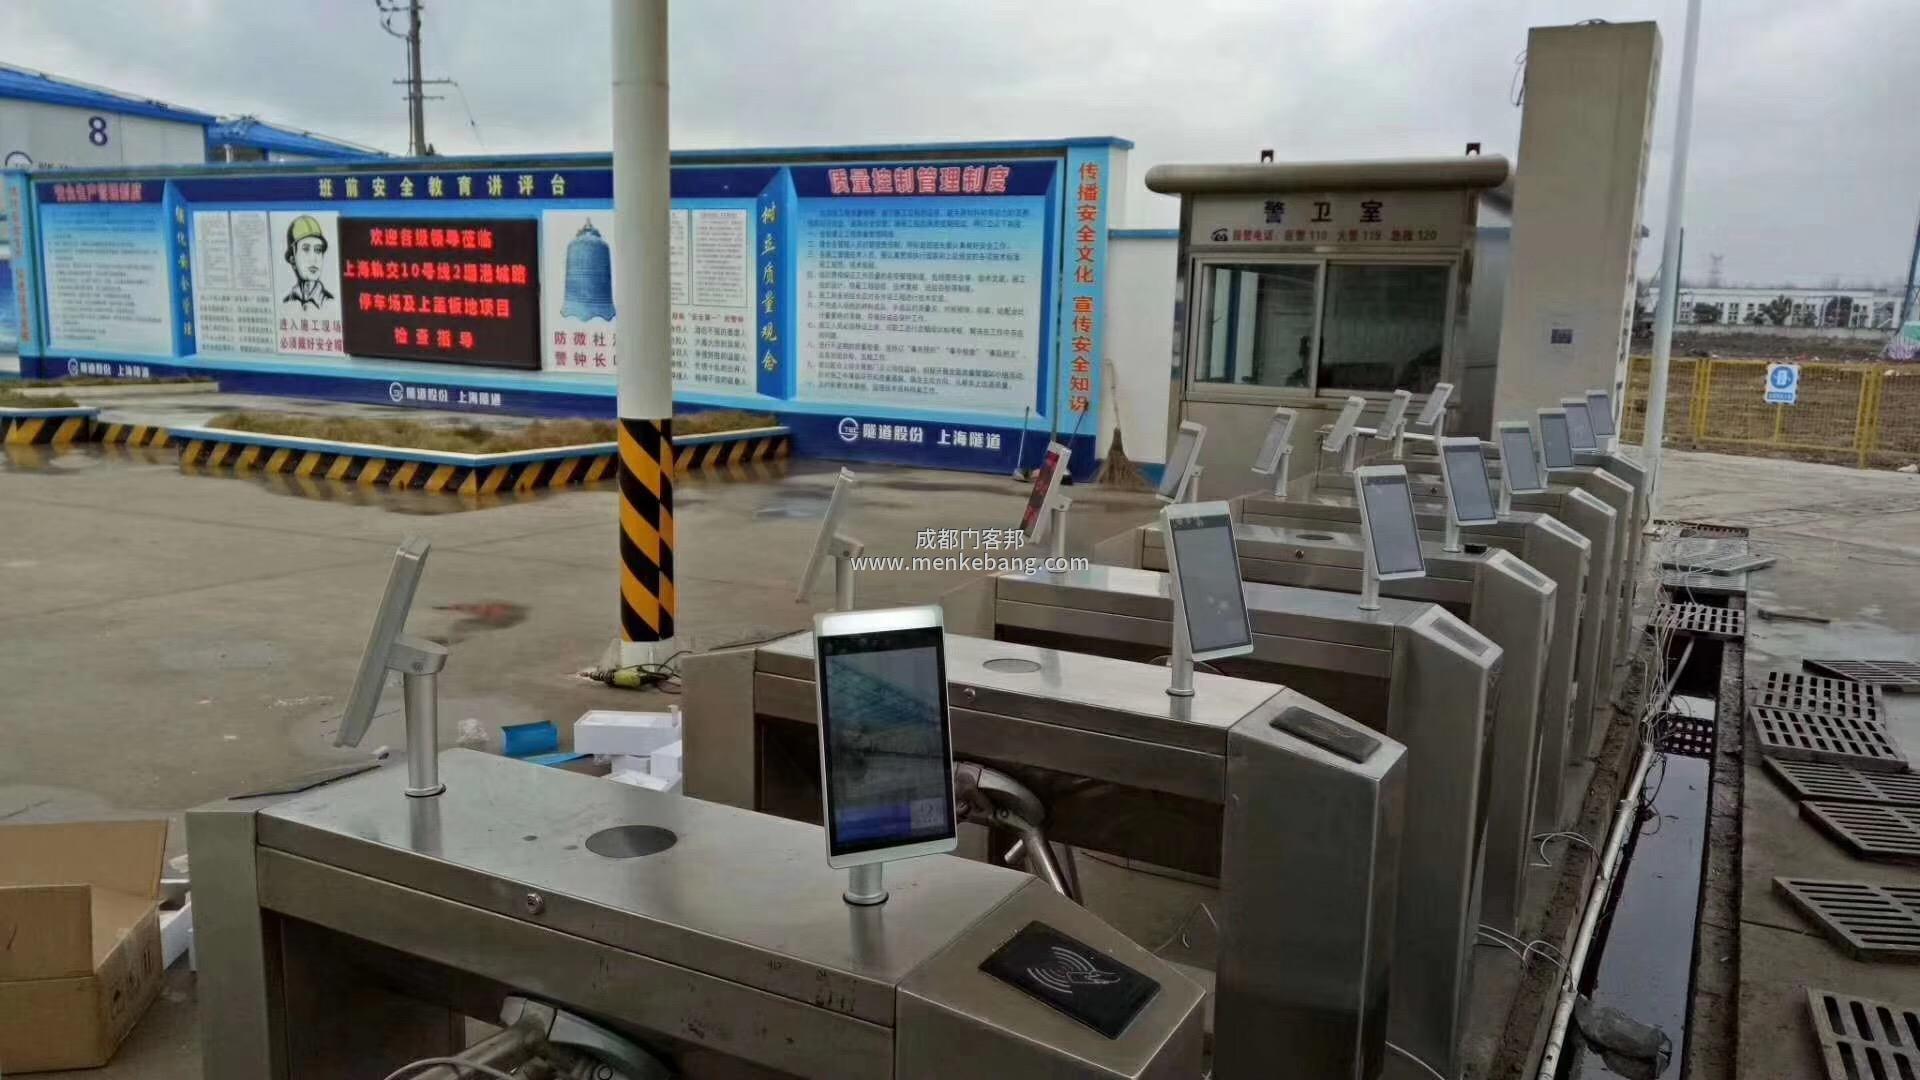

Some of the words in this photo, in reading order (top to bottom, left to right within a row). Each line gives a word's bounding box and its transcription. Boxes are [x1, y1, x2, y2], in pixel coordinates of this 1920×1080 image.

[88, 116, 108, 146] 8
[318, 173, 566, 197] 班前安全教育讲评台
[828, 165, 1010, 194] 质量控制管理制度
[1075, 162, 1099, 283] 传播安全文化
[1264, 200, 1384, 224] 警卫室
[370, 227, 493, 249] 欢迎各级领导莅临
[1418, 229, 1438, 241] 120
[394, 327, 475, 348] 检查指导
[554, 331, 616, 346] 防微杜
[555, 352, 616, 367] 警钟长
[1069, 296, 1093, 413] 宣传安全知识
[862, 423, 924, 443] 隧道股份
[937, 429, 1001, 449] 上海隧道
